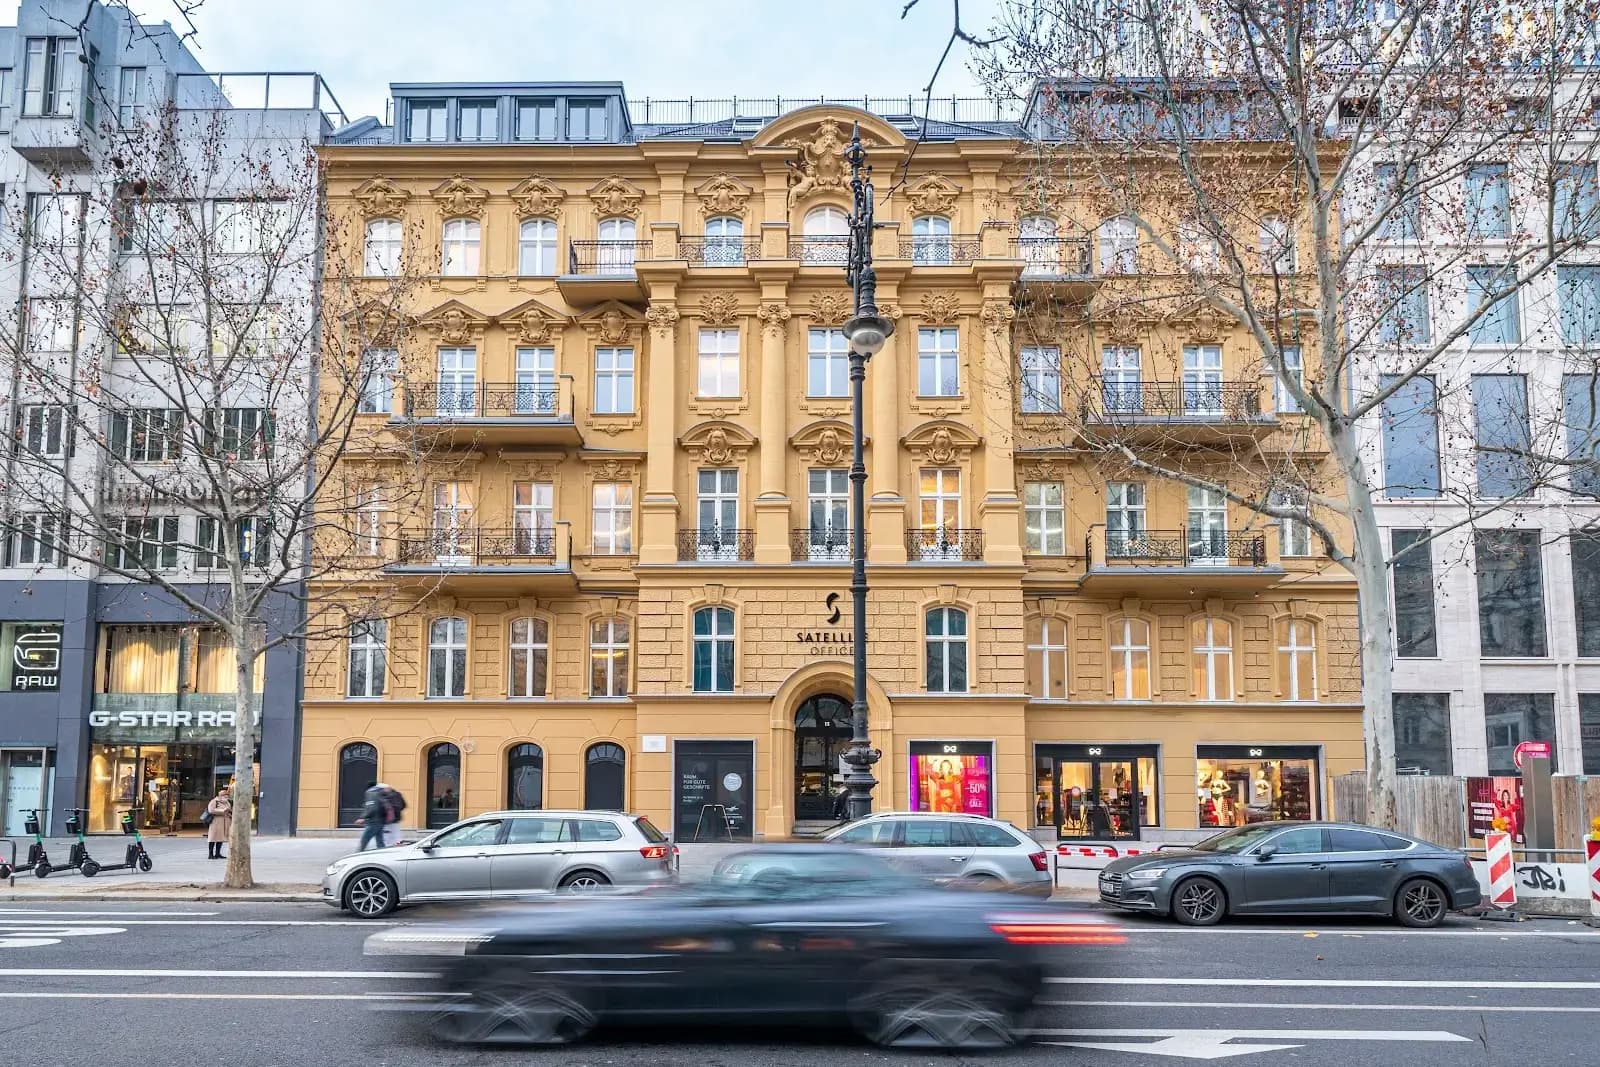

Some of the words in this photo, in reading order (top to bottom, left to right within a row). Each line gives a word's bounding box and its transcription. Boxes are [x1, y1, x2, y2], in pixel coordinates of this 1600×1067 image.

[15, 675, 57, 687] RAW
[89, 710, 193, 727] G-STAR
[197, 710, 259, 727] RA
